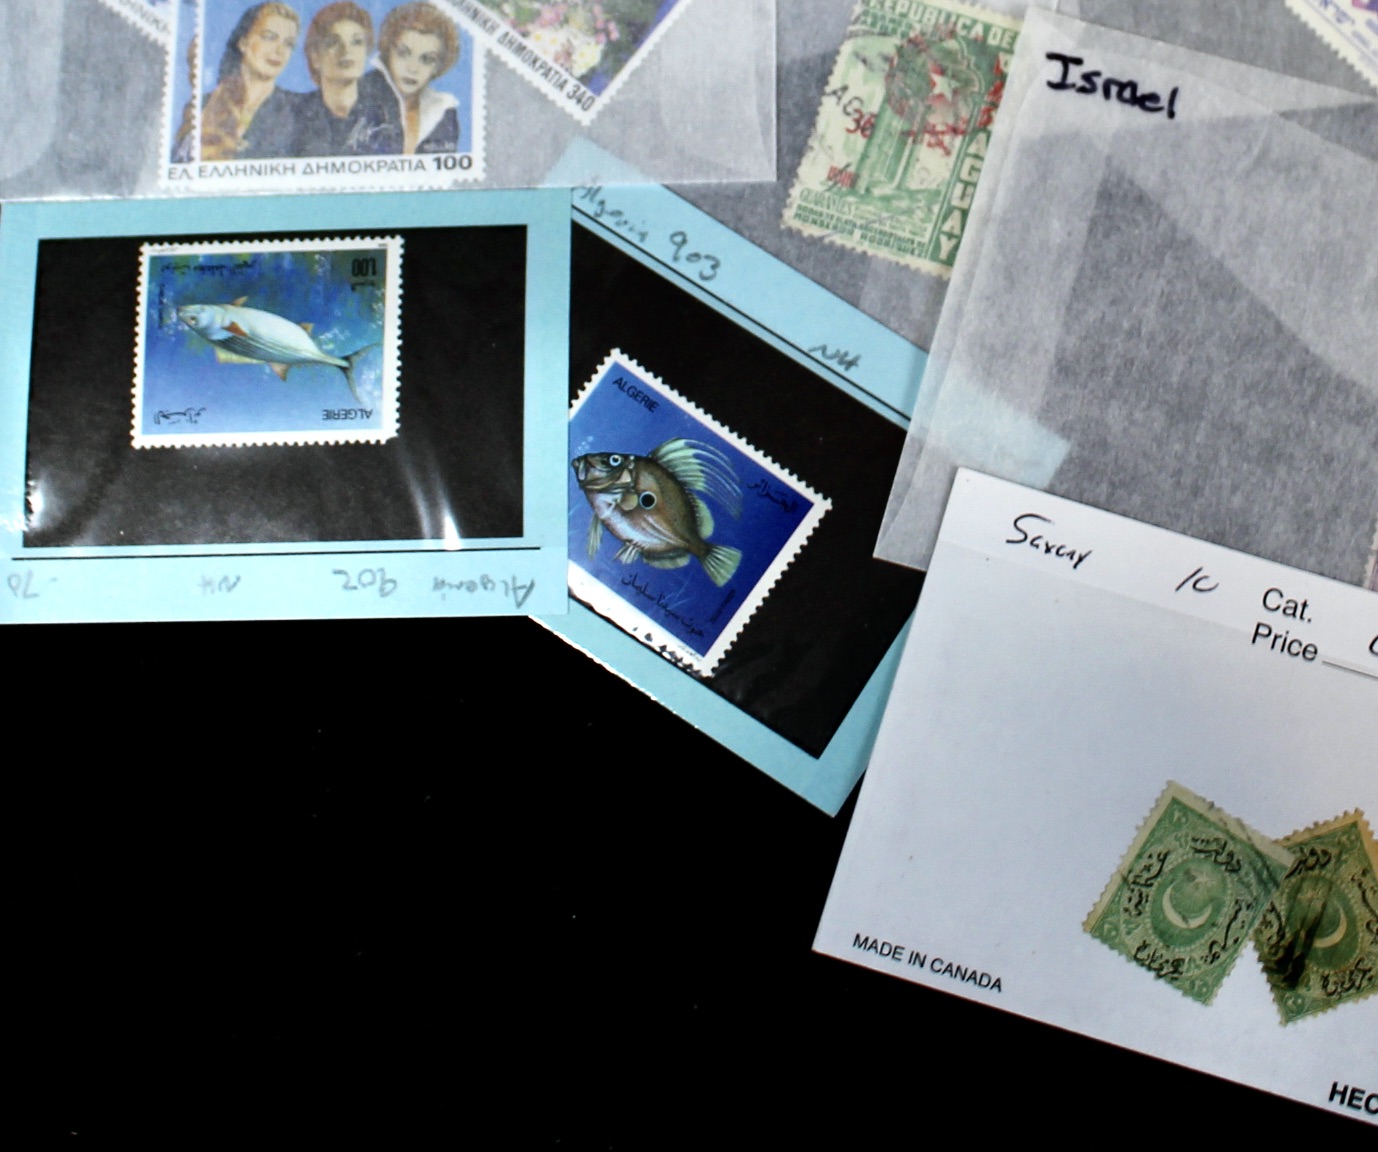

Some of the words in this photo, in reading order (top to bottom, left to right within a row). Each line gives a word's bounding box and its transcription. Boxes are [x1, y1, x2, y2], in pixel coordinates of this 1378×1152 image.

[565, 82, 596, 112] 340
[1045, 51, 1180, 120] Israel
[199, 162, 297, 179] ΕΛΛΗΝΙΚΗ
[302, 160, 426, 176] ΔΗΜΟΚΡΑΤΙΑ
[432, 154, 473, 171] 100
[669, 230, 721, 283] 903
[321, 408, 374, 421] ALGERIE
[612, 375, 660, 415] ALGERIE
[332, 566, 399, 599] 902
[1261, 586, 1313, 624] Cat.
[1250, 621, 1319, 663] Price
[852, 932, 906, 962] MADE
[907, 949, 928, 969] IN
[930, 957, 1003, 994] CANADA
